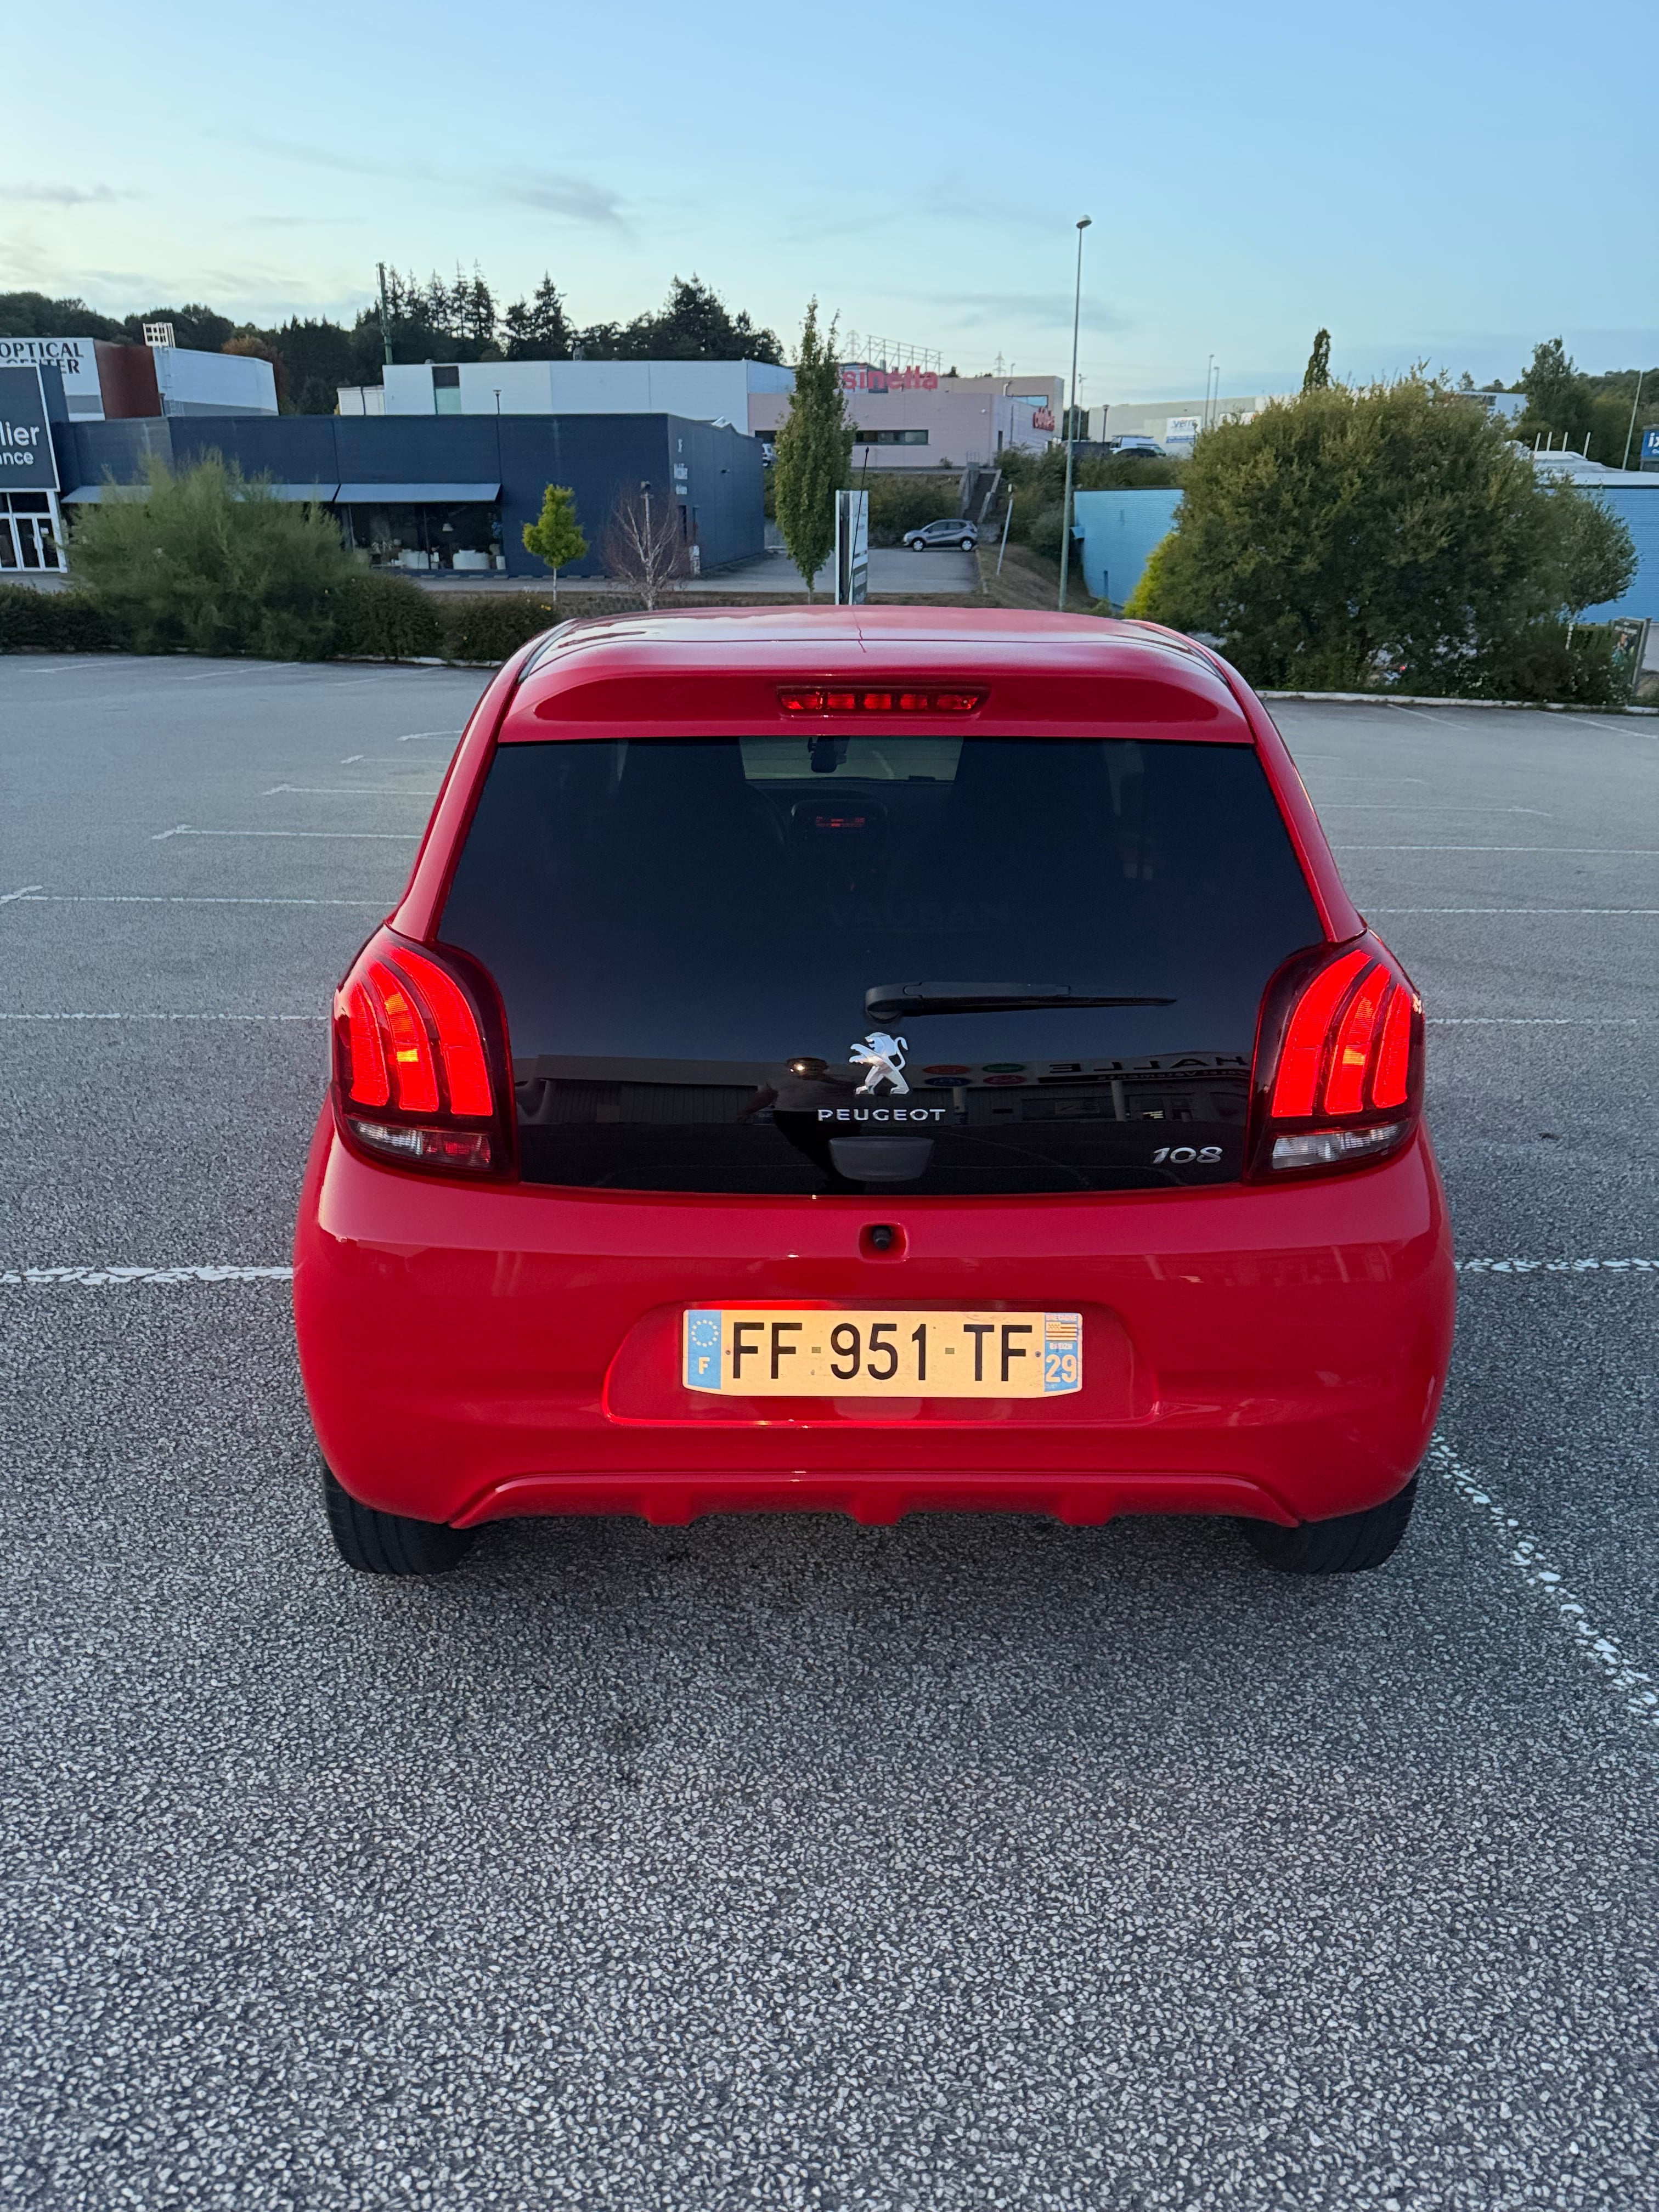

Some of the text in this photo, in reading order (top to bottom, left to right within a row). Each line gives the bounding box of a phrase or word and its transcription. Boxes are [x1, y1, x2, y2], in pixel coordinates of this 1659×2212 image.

[0, 342, 84, 358] OPTICAL
[838, 364, 938, 390] sinella
[817, 1109, 946, 1121] PEUGEOT
[1153, 1146, 1223, 1164] 108
[698, 1357, 710, 1374] F
[1046, 1354, 1077, 1383] 29
